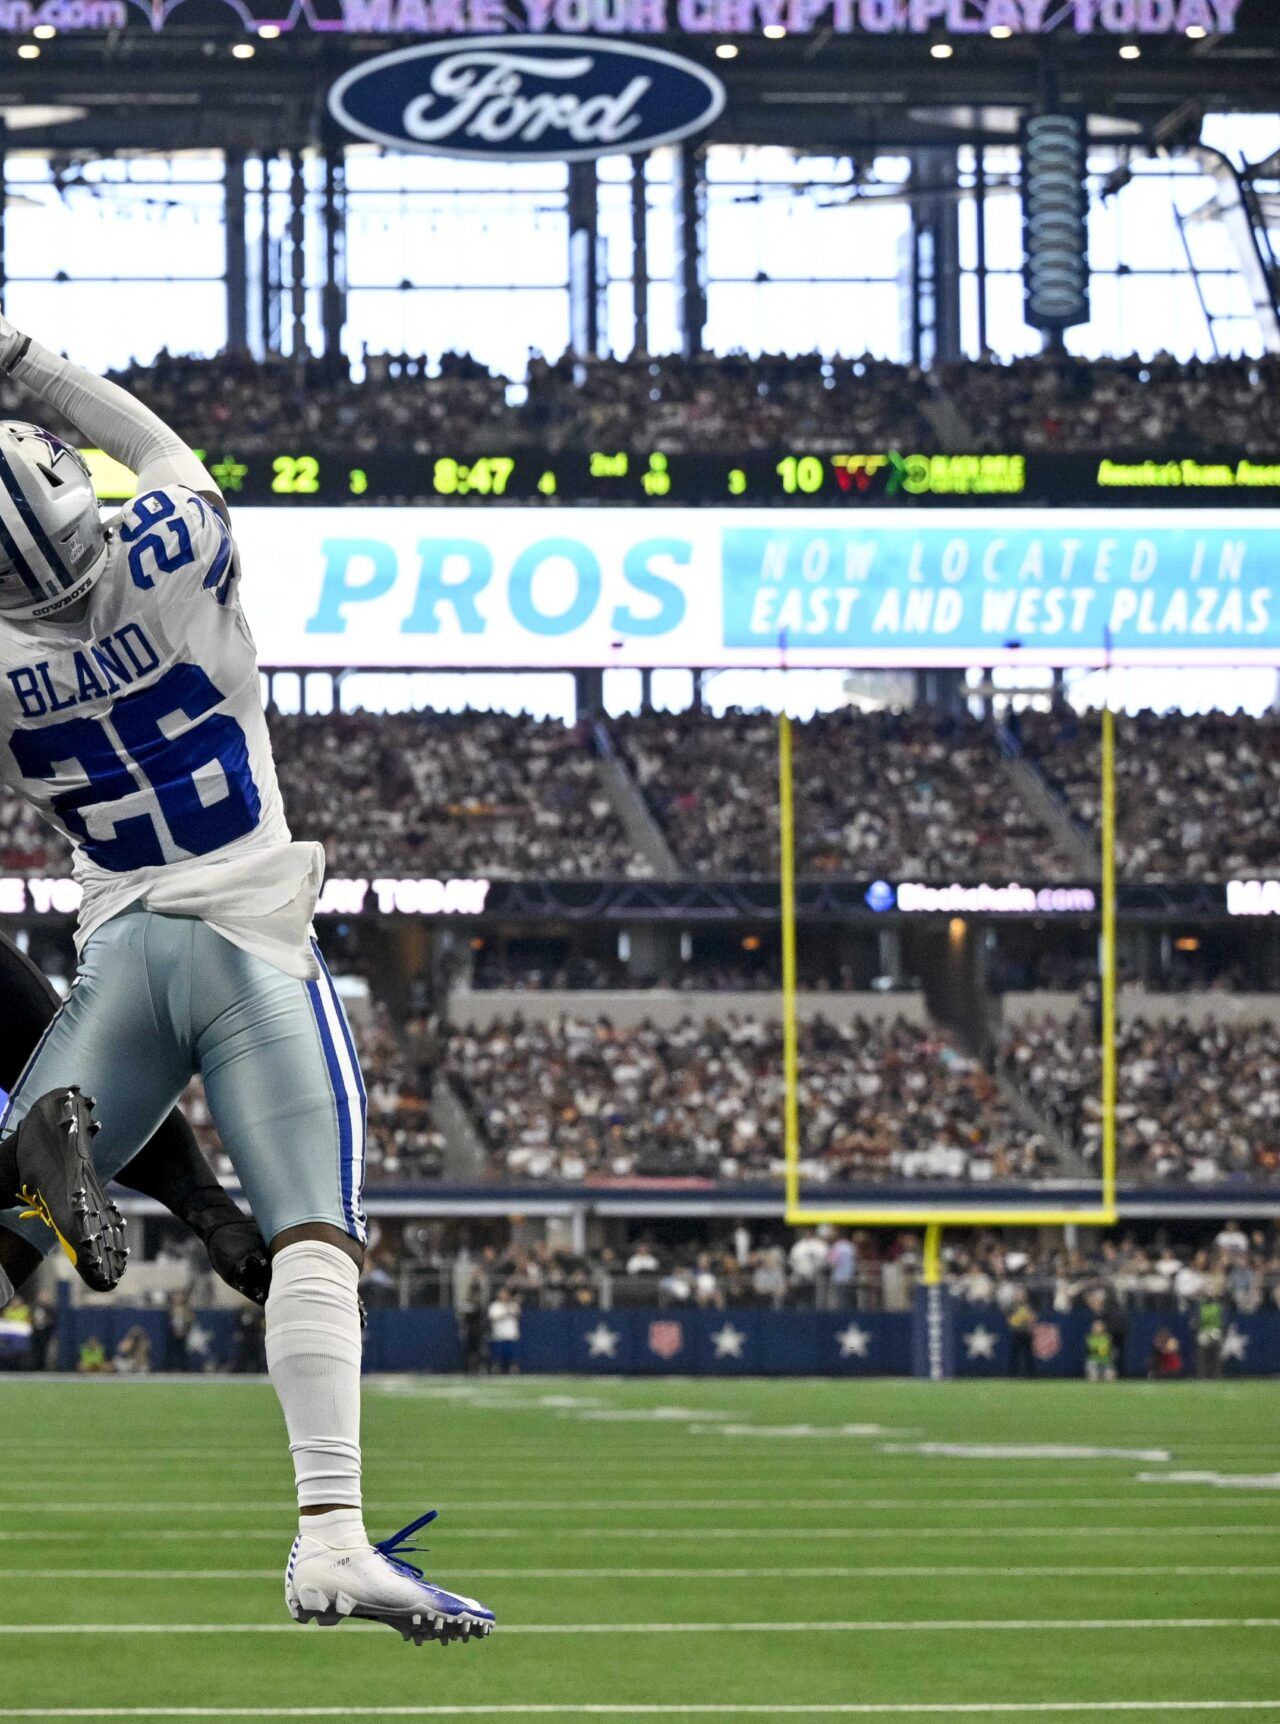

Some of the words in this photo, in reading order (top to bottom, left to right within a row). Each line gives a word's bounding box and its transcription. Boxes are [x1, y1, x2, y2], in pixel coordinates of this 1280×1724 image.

[342, 0, 506, 33] MAKE
[526, 0, 667, 33] YOUR
[677, 0, 892, 34] CRYPTO
[910, 0, 1047, 34] PLAY
[1070, 0, 1237, 34] TODAY
[403, 51, 654, 142] Ford
[272, 455, 320, 494] 22
[433, 457, 515, 495] 8:47
[776, 455, 824, 494] 10
[119, 490, 195, 591] 26
[760, 538, 878, 583] NOW
[907, 538, 1159, 583] LOCATED
[1189, 538, 1247, 583] IN
[32, 577, 92, 616] COWBOYS
[304, 536, 694, 637] PROS
[749, 586, 861, 635] EAST
[871, 586, 964, 635] AND
[981, 586, 1097, 635] WEST
[1109, 586, 1273, 635] PLAZAS
[7, 622, 161, 719] BLAND
[9, 662, 262, 872] 26
[372, 878, 490, 914] TODAY
